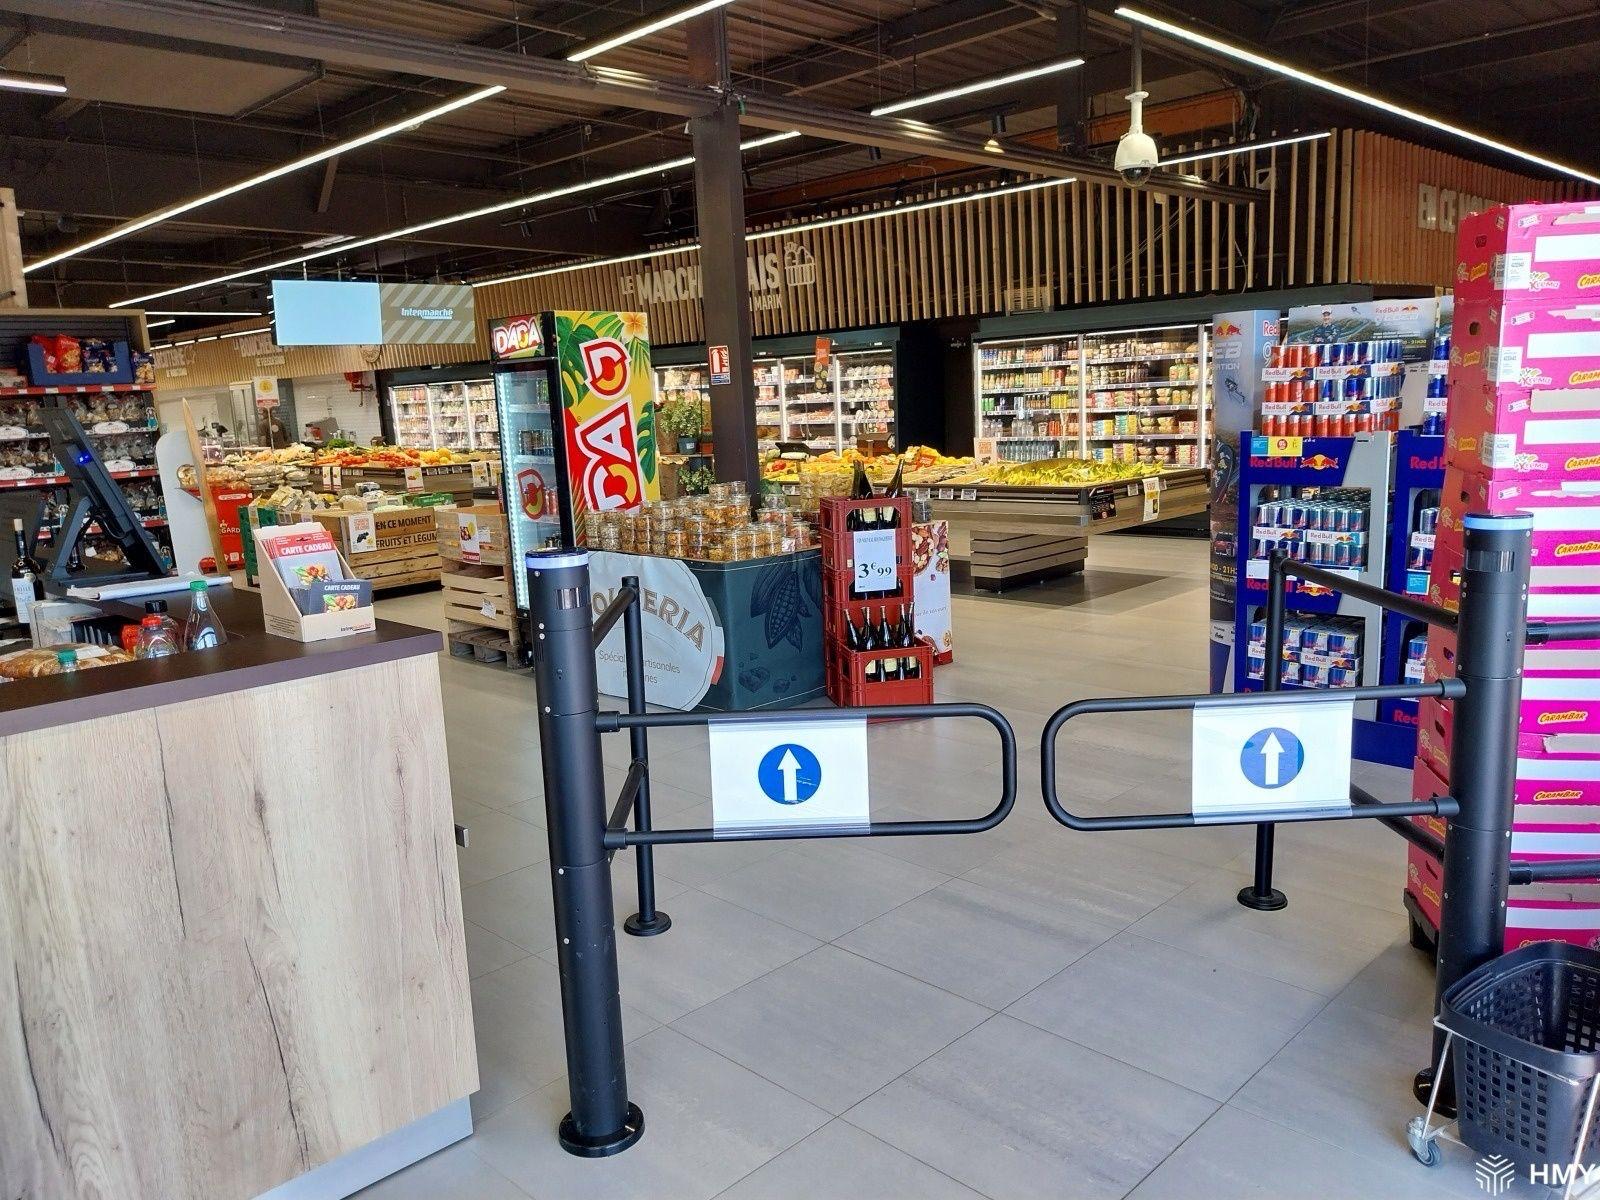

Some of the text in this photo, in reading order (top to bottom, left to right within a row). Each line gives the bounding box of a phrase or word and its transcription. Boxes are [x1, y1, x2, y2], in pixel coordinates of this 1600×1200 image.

[619, 252, 779, 305] LE MARCH AIS
[494, 319, 543, 355] DADA
[1250, 456, 1297, 469] Red Bull
[1410, 456, 1438, 470] Red
[398, 515, 432, 527] MOMENT
[281, 542, 332, 556] CARTE CADEAU
[375, 537, 402, 548] FRUITS
[404, 536, 412, 545] ET
[592, 587, 705, 652] OERIA
[598, 649, 681, 674] Spécial rtisanales
